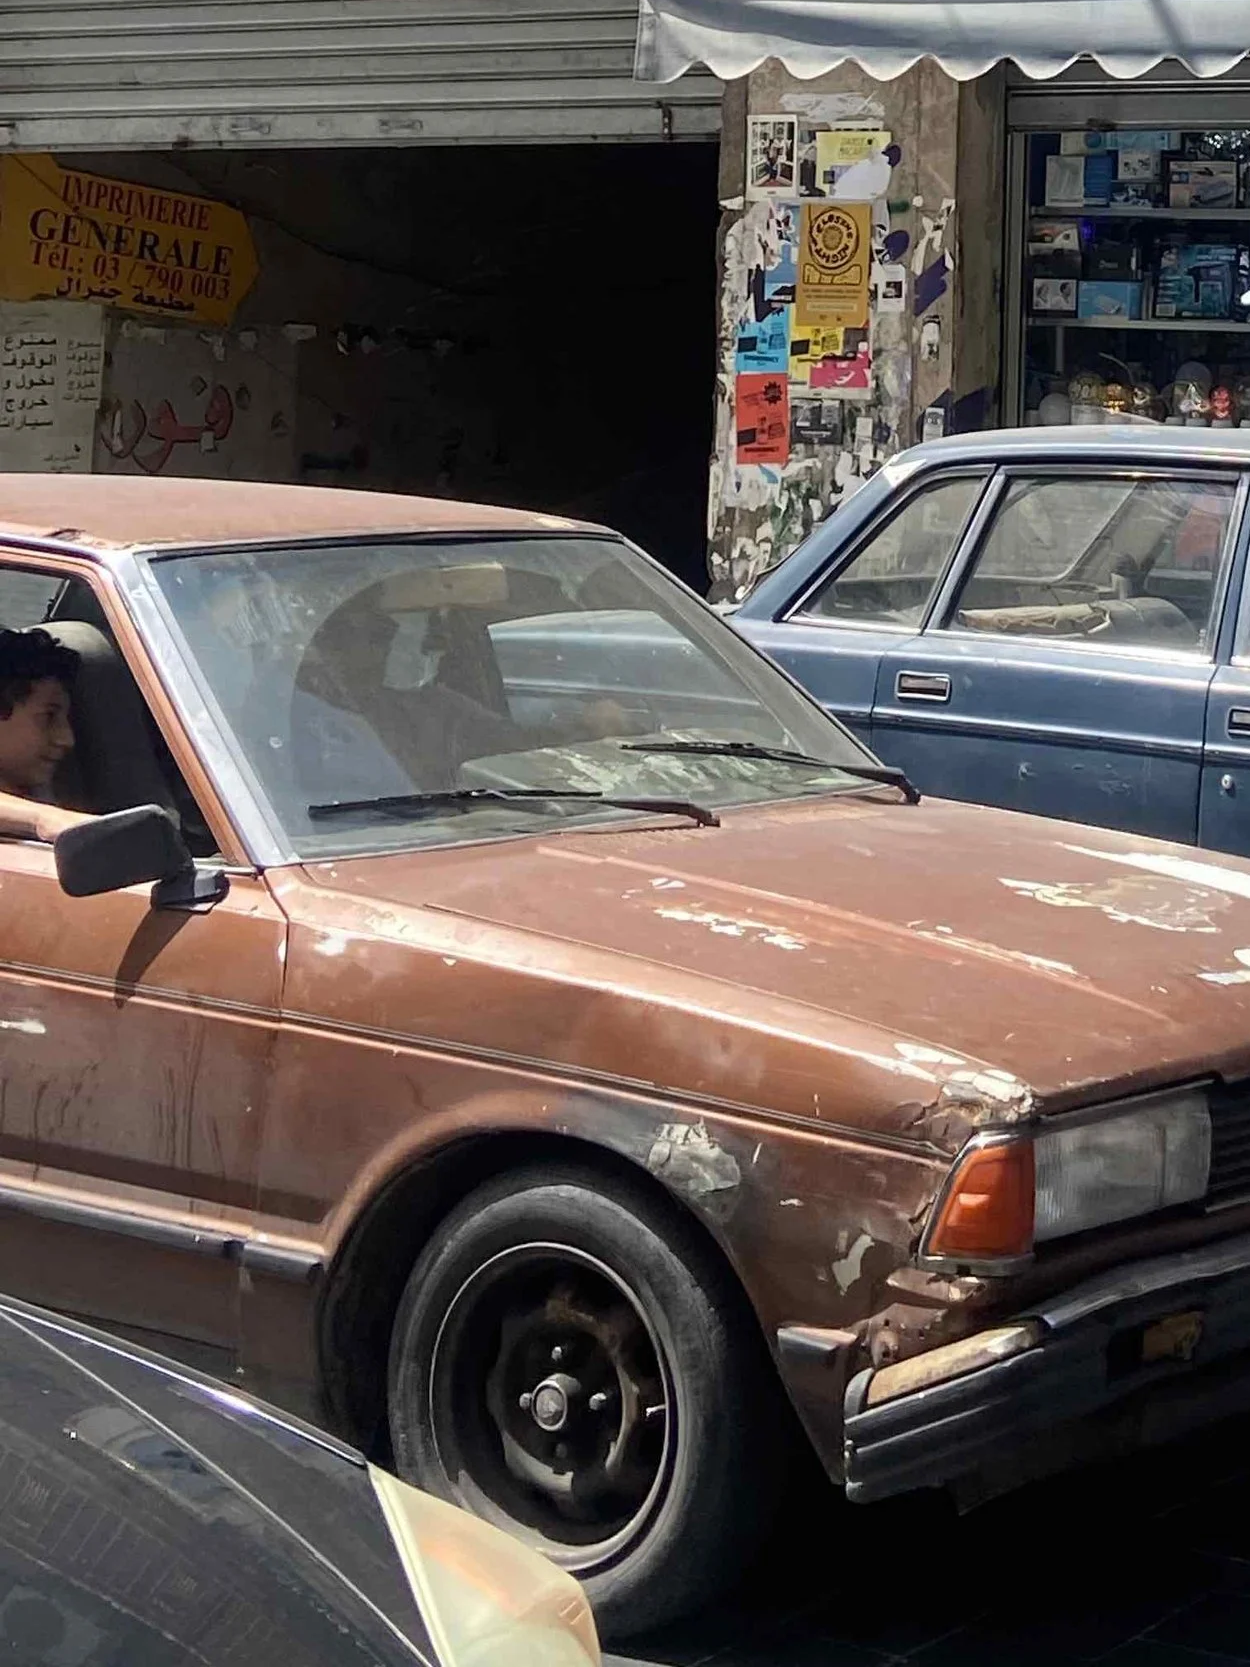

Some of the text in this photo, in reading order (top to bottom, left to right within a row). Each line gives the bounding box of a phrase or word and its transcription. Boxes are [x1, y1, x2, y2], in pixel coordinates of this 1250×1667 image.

[62, 174, 212, 232] IMPRIMERIE
[30, 205, 235, 277] GÉNÉRALE
[191, 272, 231, 300] 003
